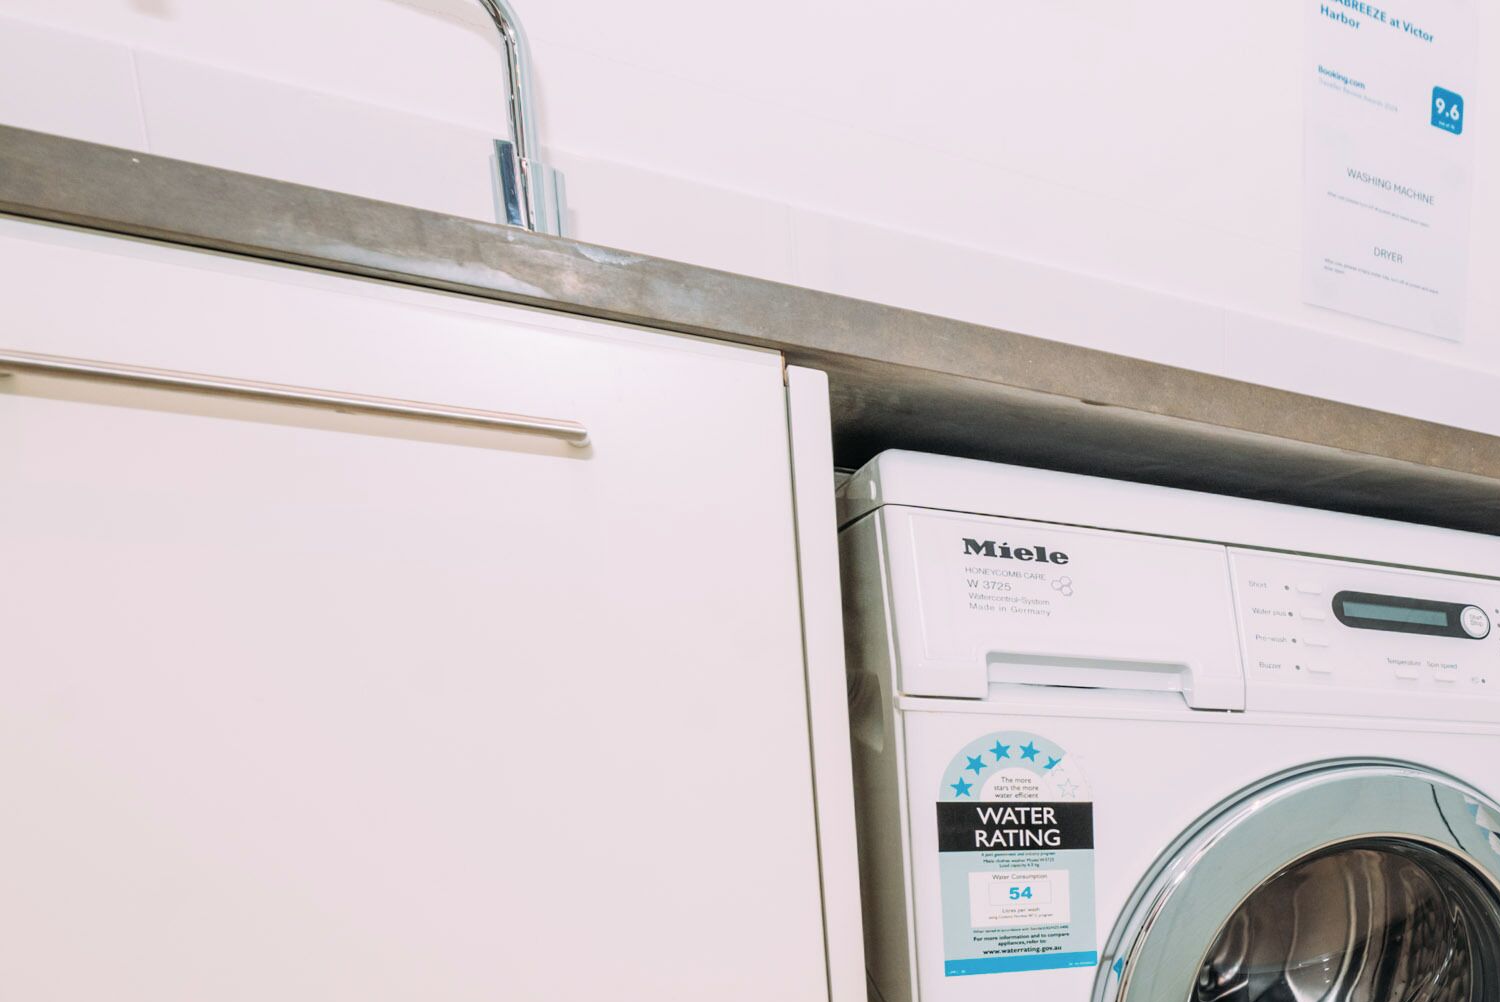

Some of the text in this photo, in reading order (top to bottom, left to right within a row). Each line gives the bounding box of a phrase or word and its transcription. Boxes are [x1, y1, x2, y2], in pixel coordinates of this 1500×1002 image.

[1320, 3, 1360, 29] Harbor
[1389, 17, 1400, 28] at
[1402, 20, 1435, 43] Victor
[1318, 65, 1366, 89] Booking.com
[1435, 97, 1460, 122] 9.6
[1347, 167, 1435, 206] WASHING MACHINE
[1373, 246, 1404, 265] DRYER
[962, 537, 1069, 565] Miele
[965, 567, 1022, 579] HONEYCOMB
[966, 579, 1012, 592] W 3725
[969, 603, 995, 611] Made
[1011, 605, 1052, 617] Germany
[976, 807, 1057, 825] WATER
[975, 829, 1061, 847] RATING
[1009, 886, 1033, 900] 54
